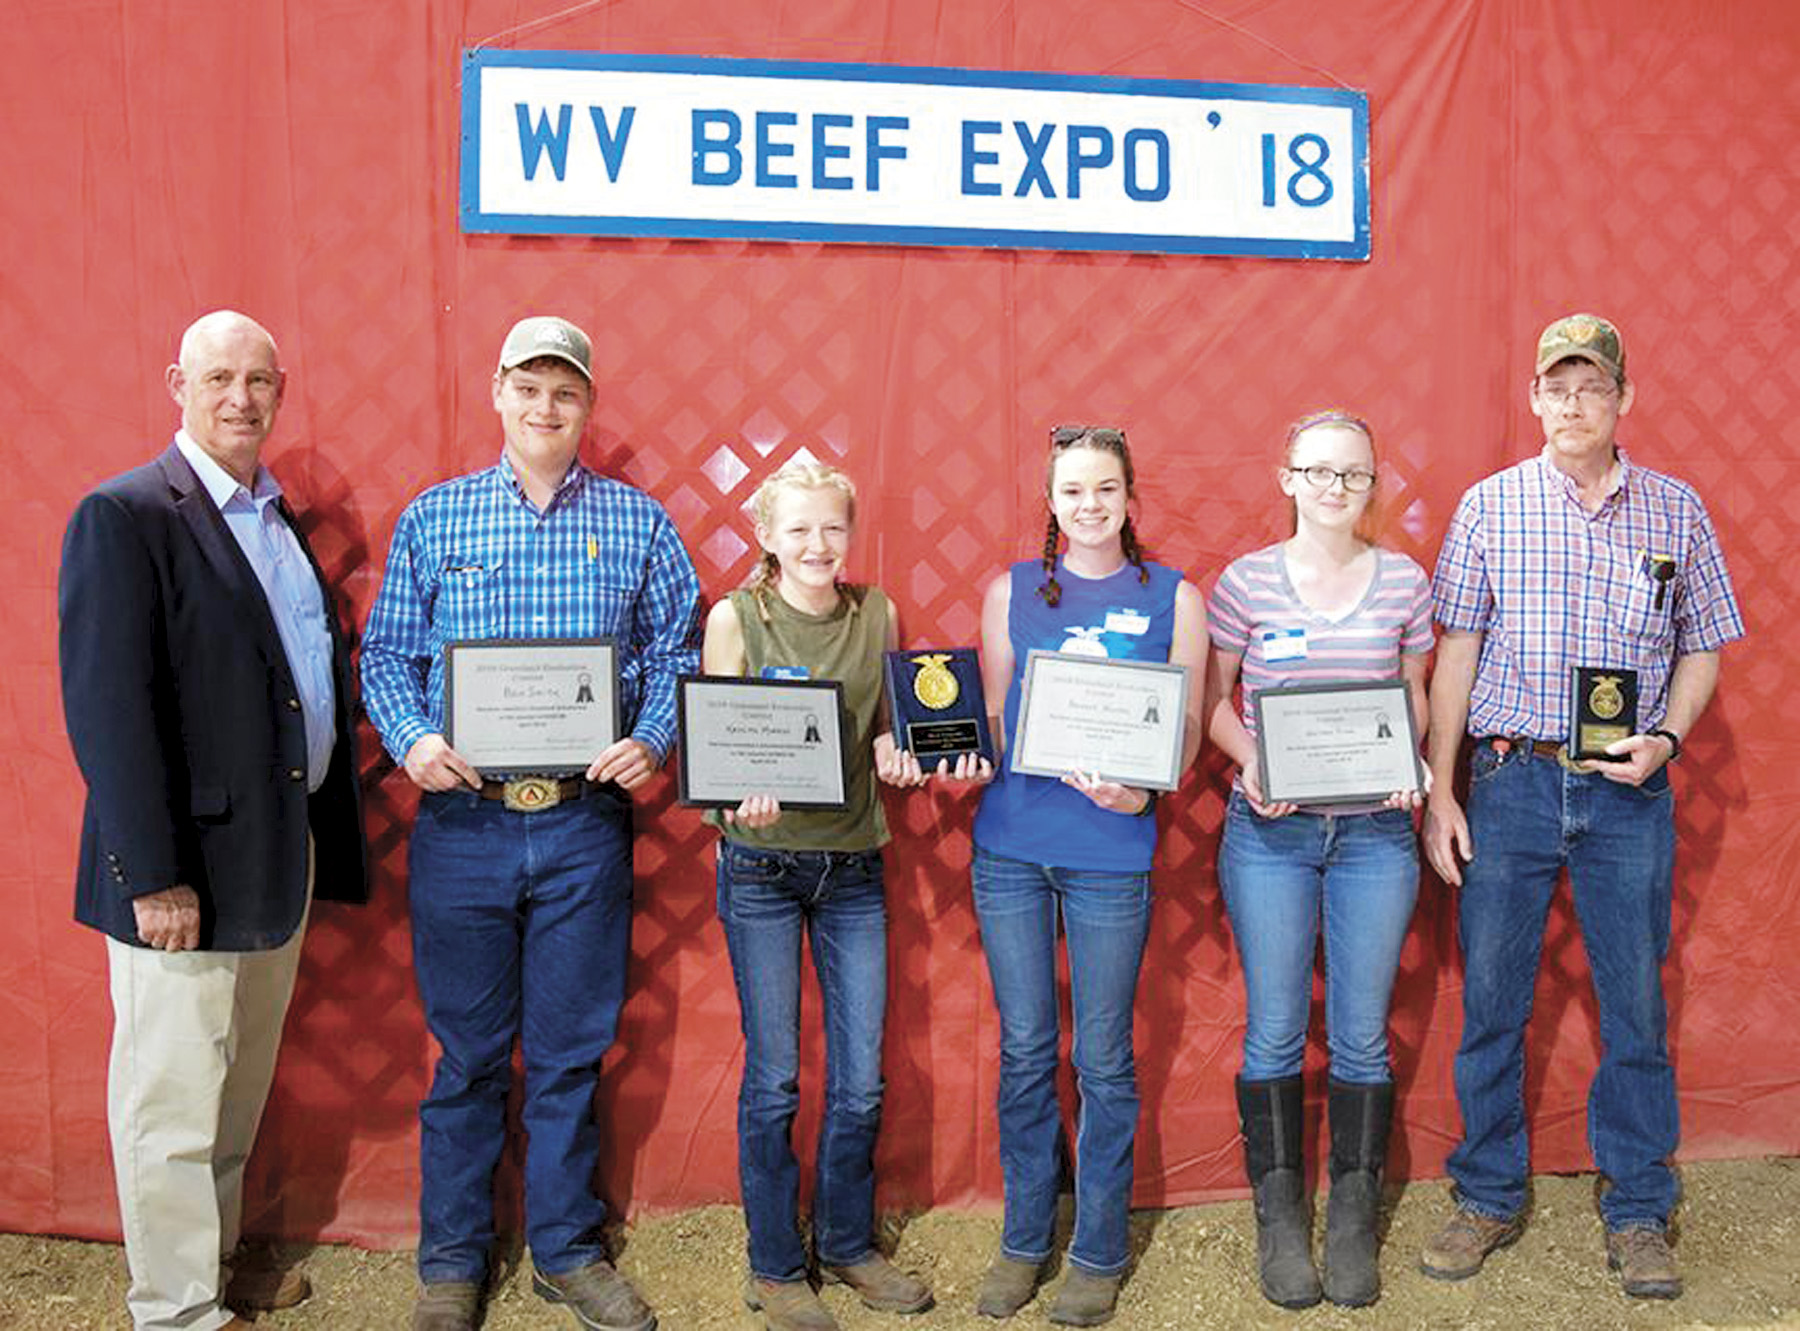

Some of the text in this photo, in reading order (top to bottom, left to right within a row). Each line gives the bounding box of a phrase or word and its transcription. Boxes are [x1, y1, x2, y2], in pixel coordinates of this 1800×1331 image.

[514, 102, 636, 184] WV
[691, 108, 910, 192] BEEF
[960, 119, 1171, 203] EXPO
